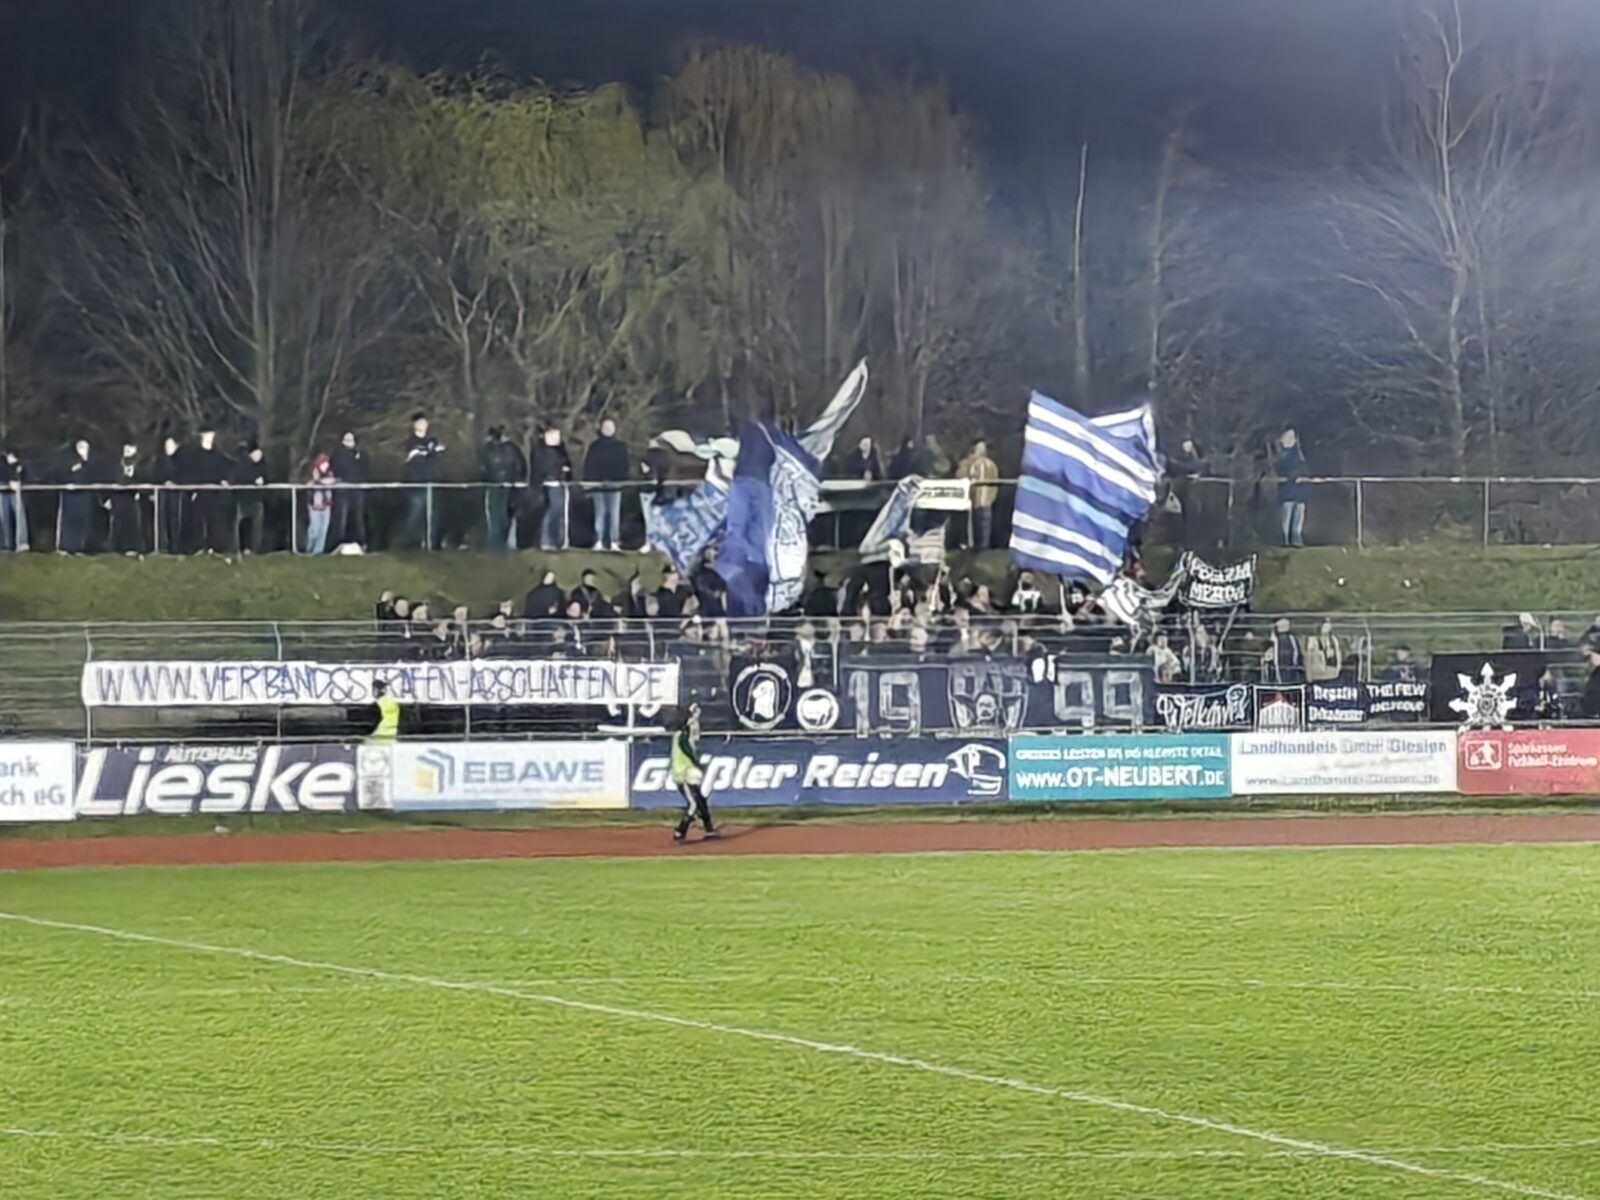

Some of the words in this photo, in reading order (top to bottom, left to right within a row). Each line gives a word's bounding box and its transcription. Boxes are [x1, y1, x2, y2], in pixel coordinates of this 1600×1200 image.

[75, 746, 355, 815] Lieske
[463, 761, 604, 783] EBAWE
[632, 754, 798, 798] Gßler
[802, 752, 949, 788] Reisen
